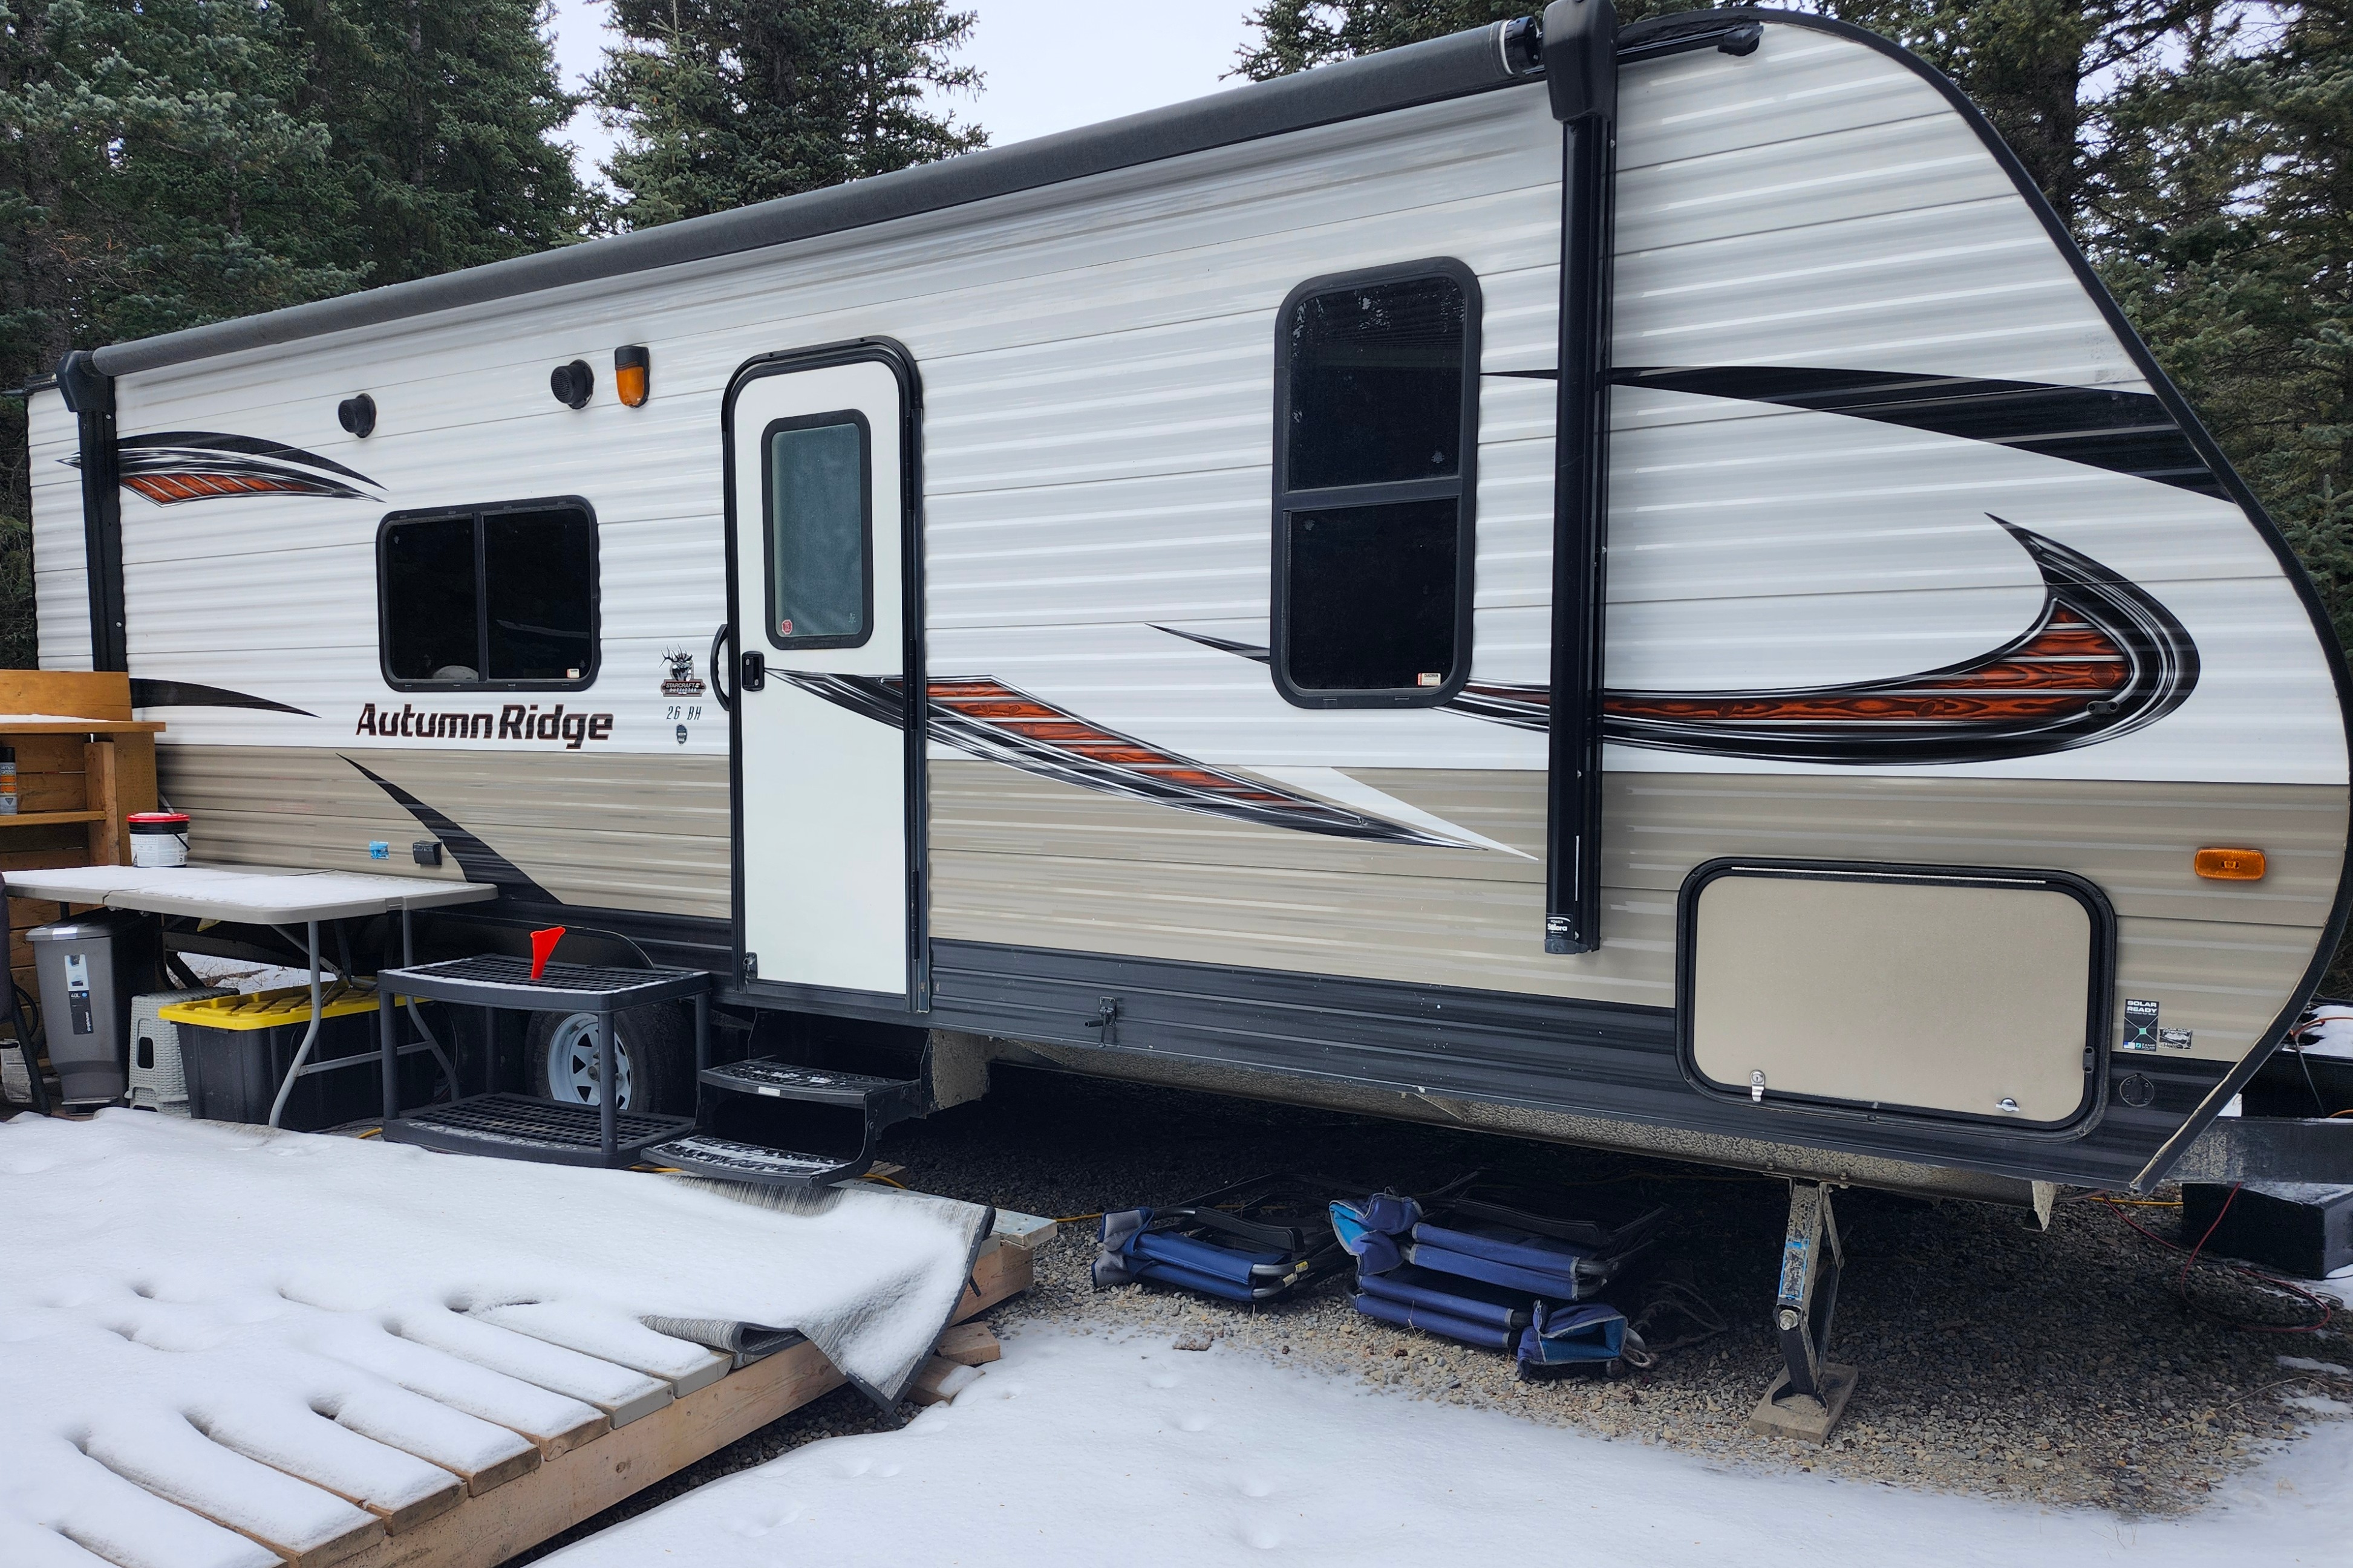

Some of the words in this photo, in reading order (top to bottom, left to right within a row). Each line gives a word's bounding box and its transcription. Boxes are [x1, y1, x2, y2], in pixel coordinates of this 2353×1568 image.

[356, 703, 493, 739] Autumn
[498, 704, 613, 749] Ridge
[666, 706, 681, 720] 26
[687, 706, 702, 720] BH
